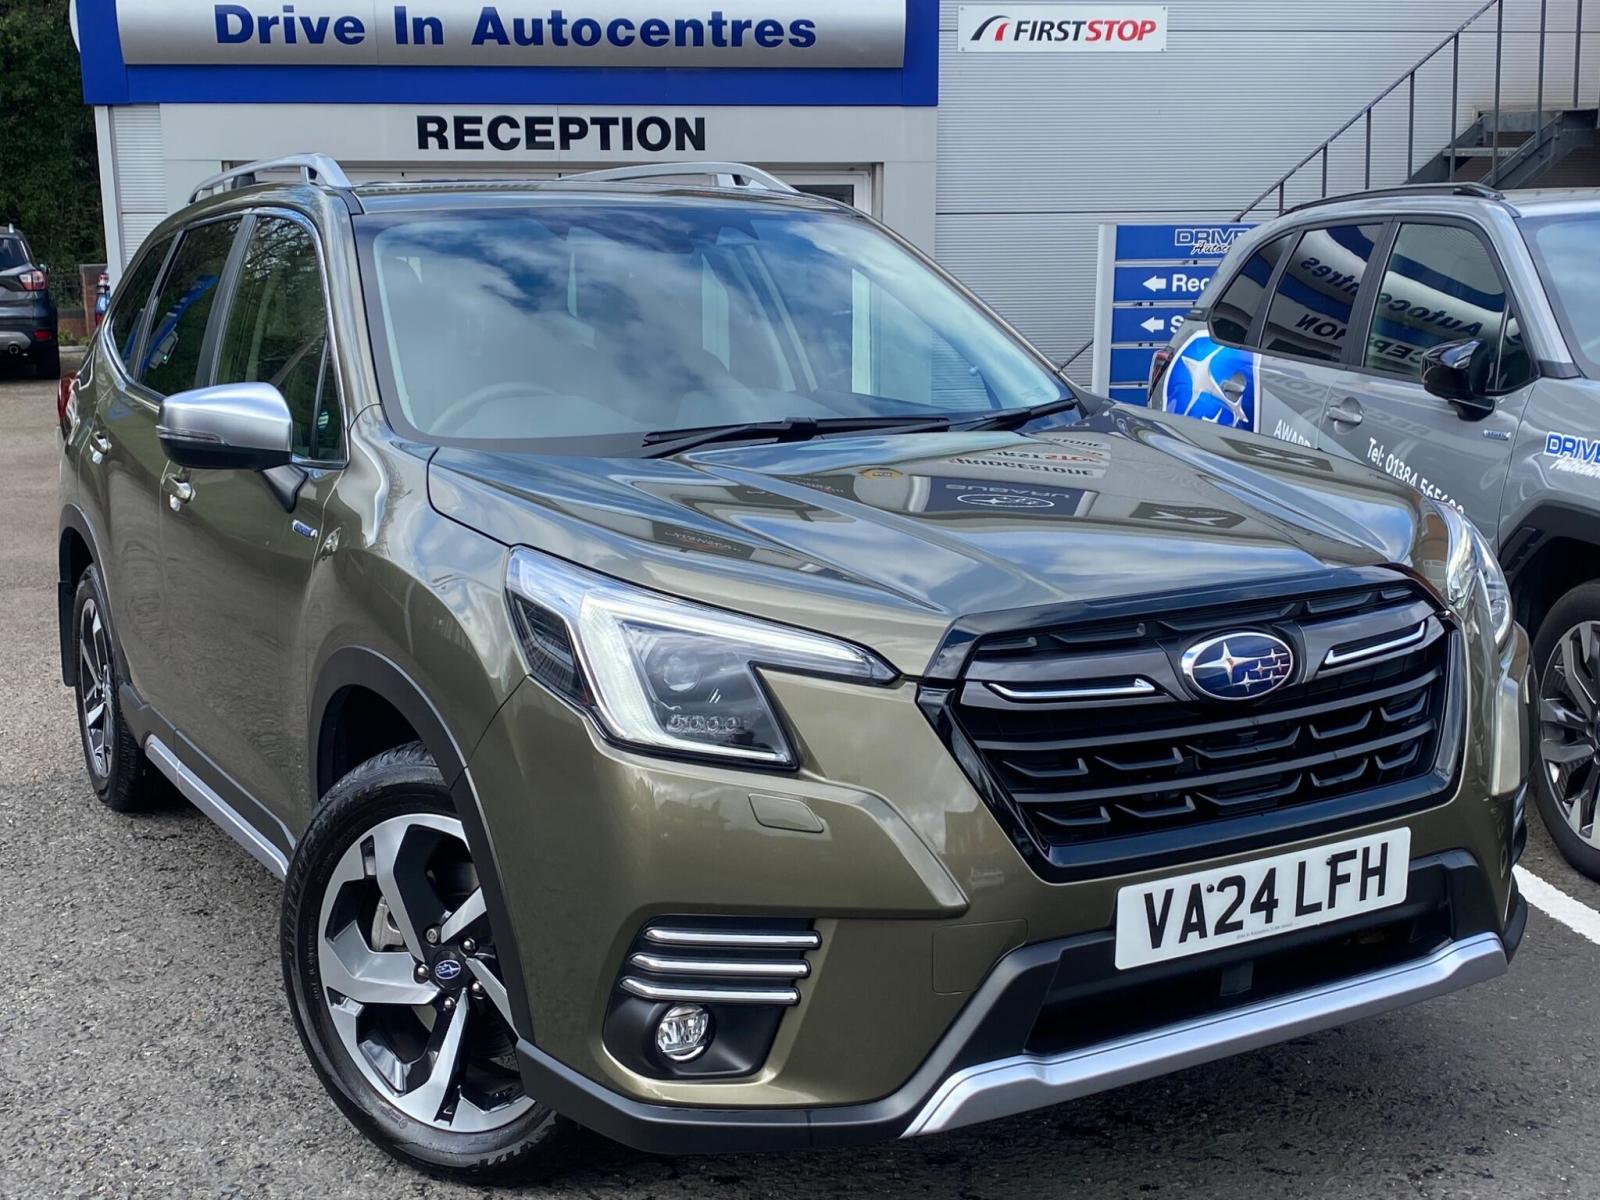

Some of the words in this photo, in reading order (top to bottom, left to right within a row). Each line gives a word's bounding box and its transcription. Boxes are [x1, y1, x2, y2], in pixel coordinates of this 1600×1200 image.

[214, 4, 365, 45] Drive
[394, 6, 444, 45] In
[471, 7, 817, 48] Autocentres
[416, 115, 706, 151] RECEPTION
[1367, 437, 1385, 467] Tel:
[1143, 867, 1279, 950] VA24
[1295, 842, 1388, 917] LFH
